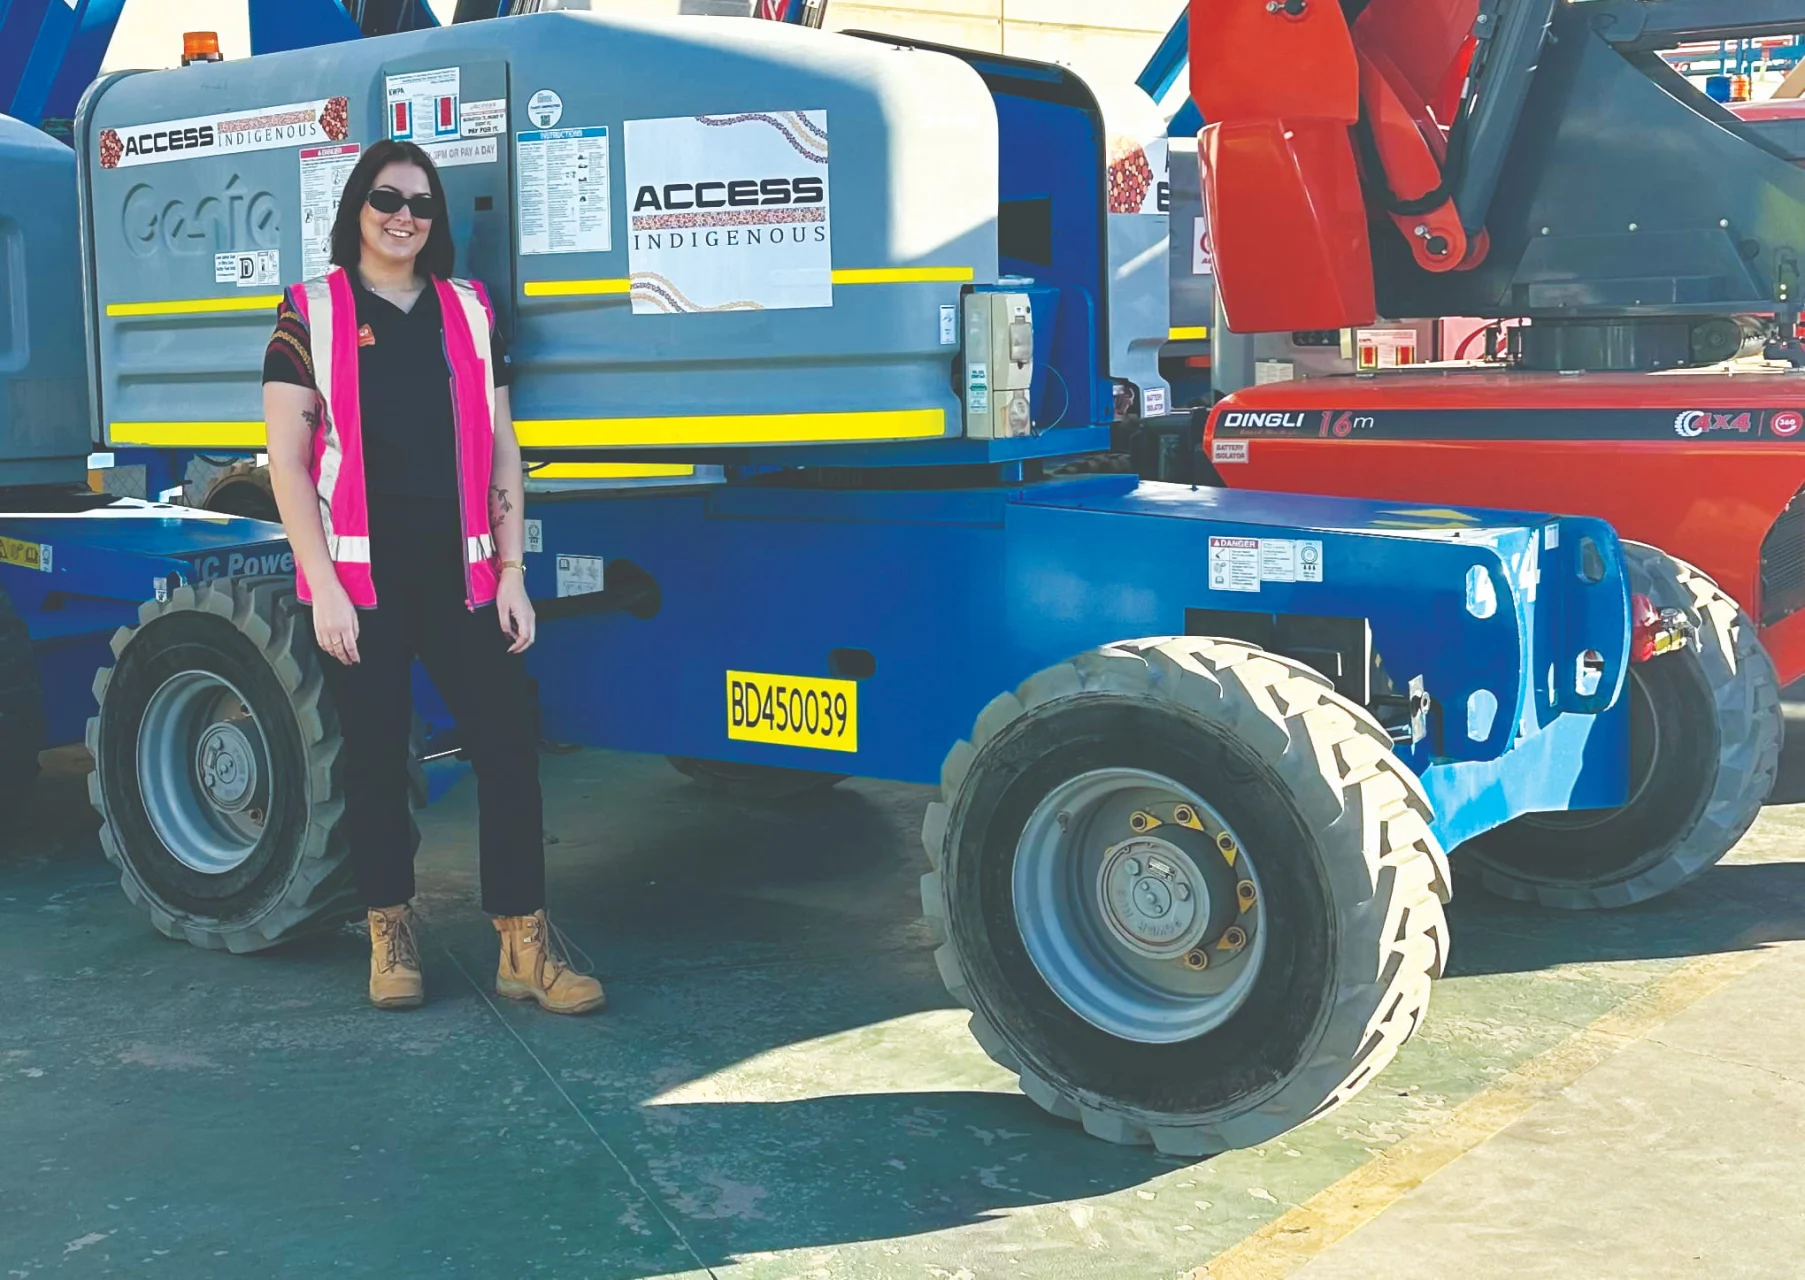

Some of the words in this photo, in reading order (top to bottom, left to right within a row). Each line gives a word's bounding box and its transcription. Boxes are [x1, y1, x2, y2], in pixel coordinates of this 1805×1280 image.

[125, 125, 214, 157] ACCESS
[217, 122, 317, 148] INDIGENOUS
[460, 146, 473, 158] PAY
[481, 144, 495, 156] DAY
[633, 176, 824, 212] ACCESS
[634, 226, 826, 250] INDIGENOUS
[1224, 413, 1305, 428] DINGLI
[1220, 539, 1256, 549] DANGER
[228, 551, 296, 578] Powe
[731, 680, 847, 738] BD450039
